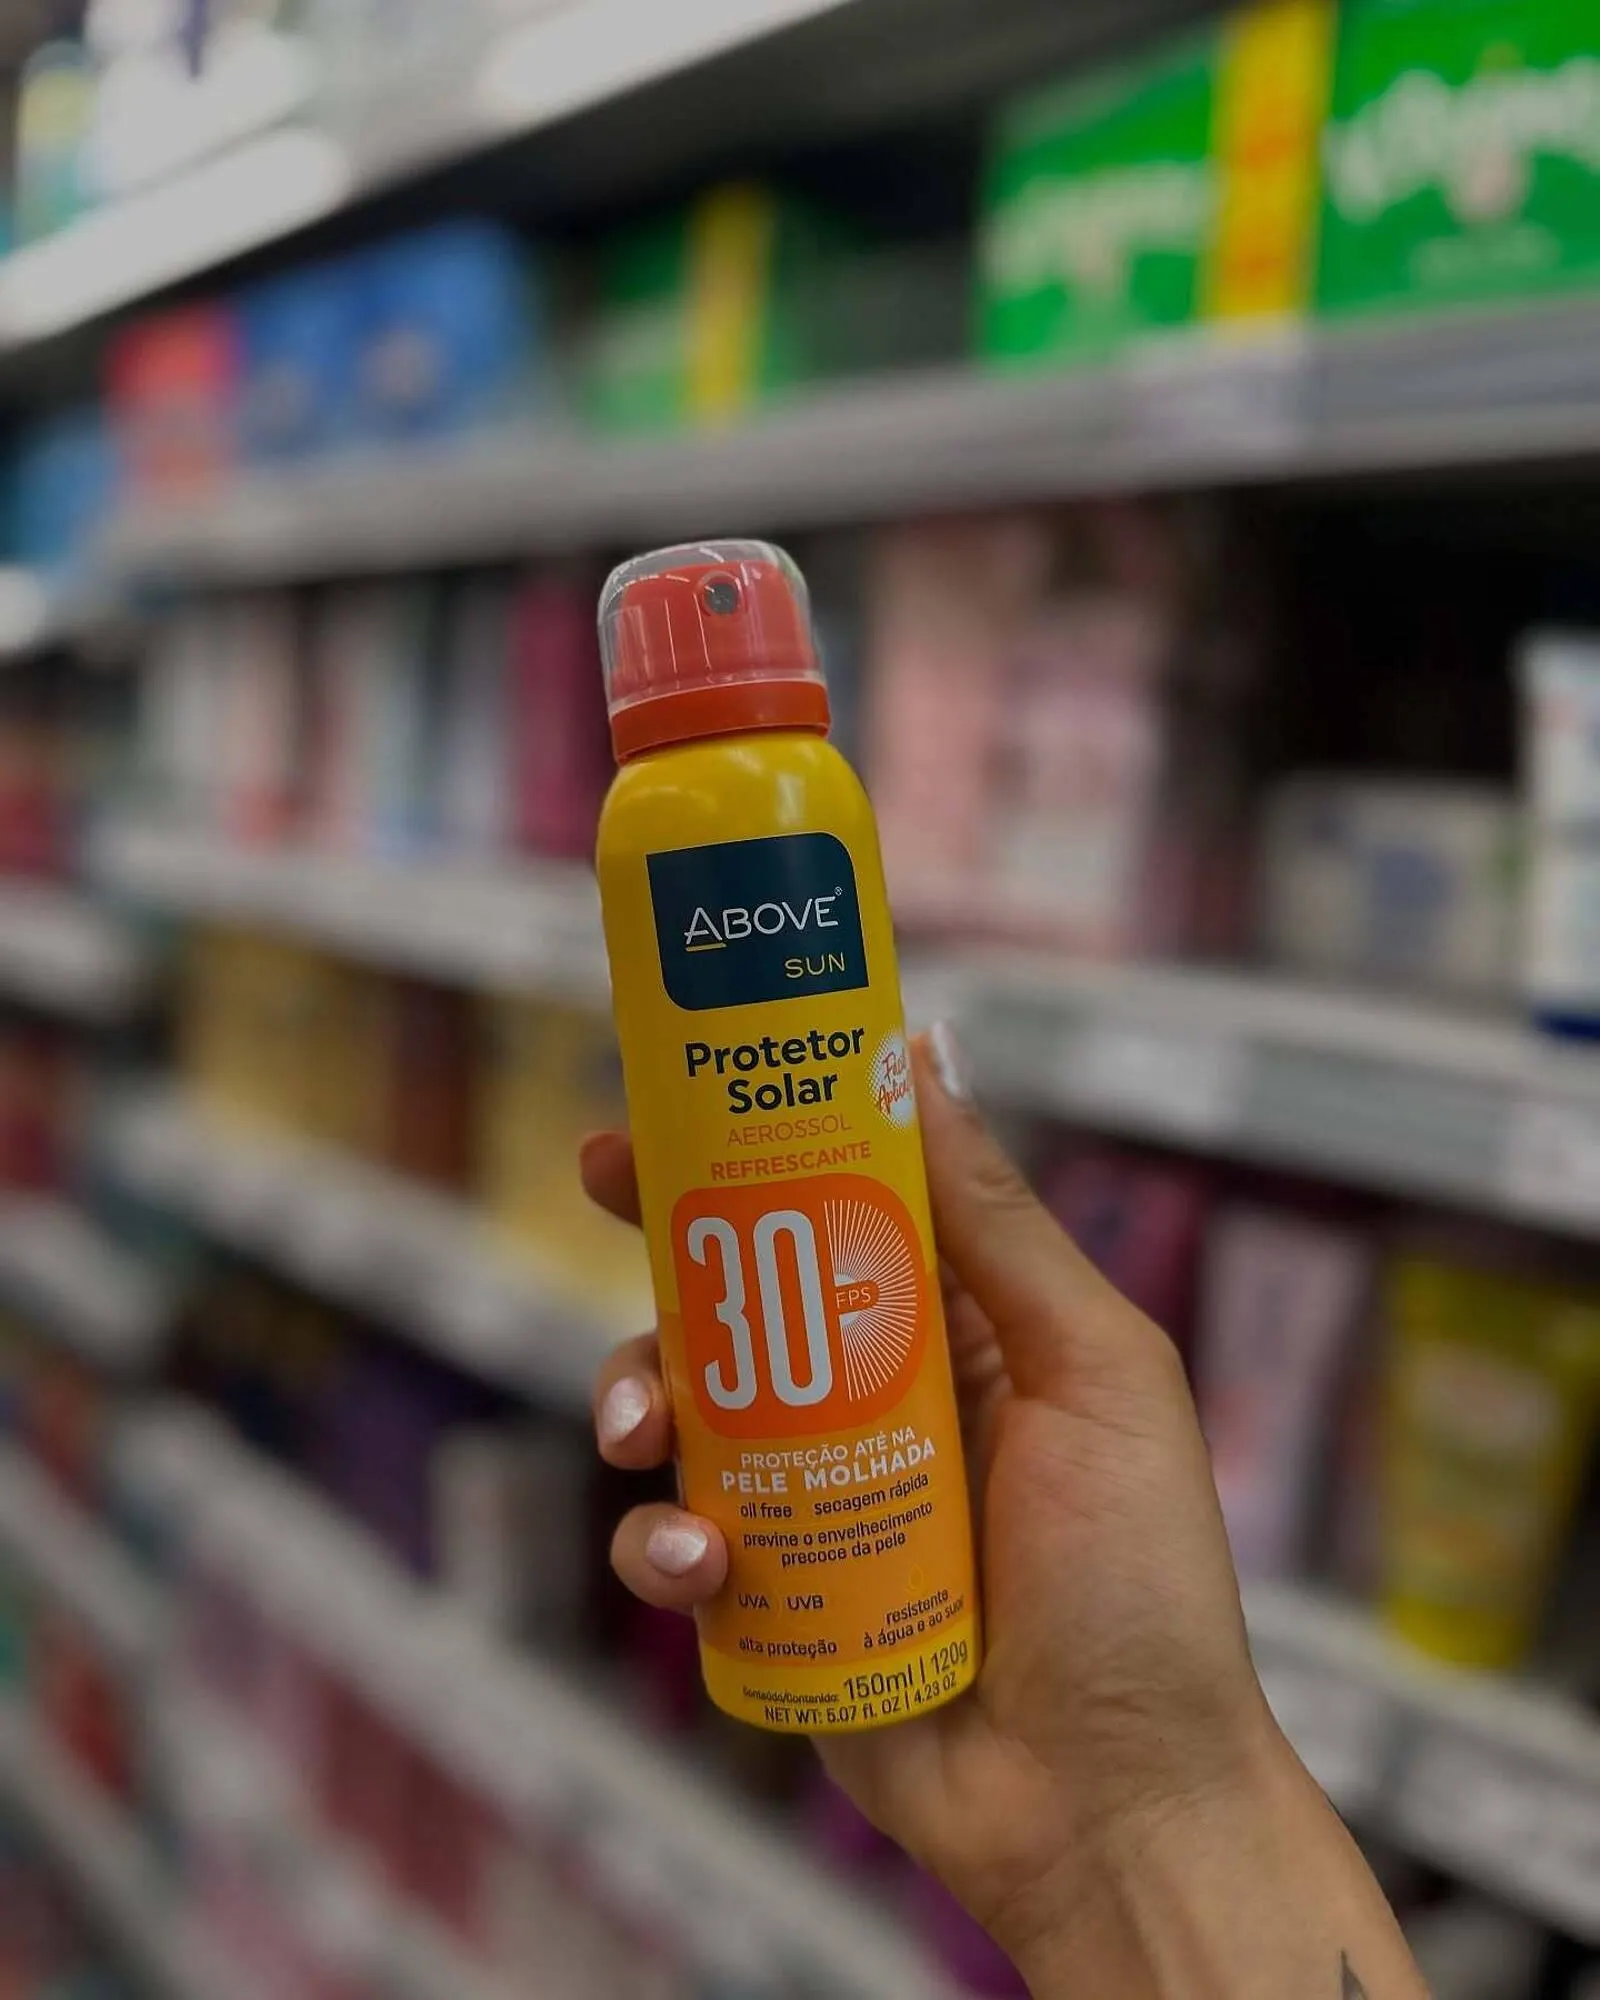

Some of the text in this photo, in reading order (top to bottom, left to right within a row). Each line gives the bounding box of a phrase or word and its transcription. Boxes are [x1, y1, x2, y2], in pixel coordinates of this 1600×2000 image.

[785, 952, 846, 979] SUN
[685, 1027, 865, 1077] Protetor
[727, 1072, 838, 1114] Solar
[727, 1114, 853, 1147] AEROSSOL
[710, 1141, 872, 1181] REFRESCANTE
[687, 1209, 833, 1410] 30
[836, 1287, 871, 1308] FPS
[721, 1438, 936, 1493] PELE MOLHADA
[741, 1426, 916, 1469] PROTEÇÃO ATÉ NA
[760, 1502, 792, 1518] free
[814, 1473, 929, 1515] secagem rápida
[743, 1502, 932, 1548] previne o envelhecimento
[781, 1531, 906, 1568] precoce da pele
[739, 1594, 824, 1610] UVA UVB
[886, 1589, 949, 1625] resistente
[739, 1636, 837, 1659] alta proteção
[864, 1631, 873, 1648] à
[878, 1625, 914, 1646] água
[917, 1620, 925, 1632] e
[929, 1611, 943, 1627] ao
[844, 1663, 913, 1700] 150ml
[931, 1640, 968, 1674] 120g
[764, 1706, 791, 1723] NET
[795, 1708, 822, 1724] WT:
[914, 1681, 940, 1703] 4.23
